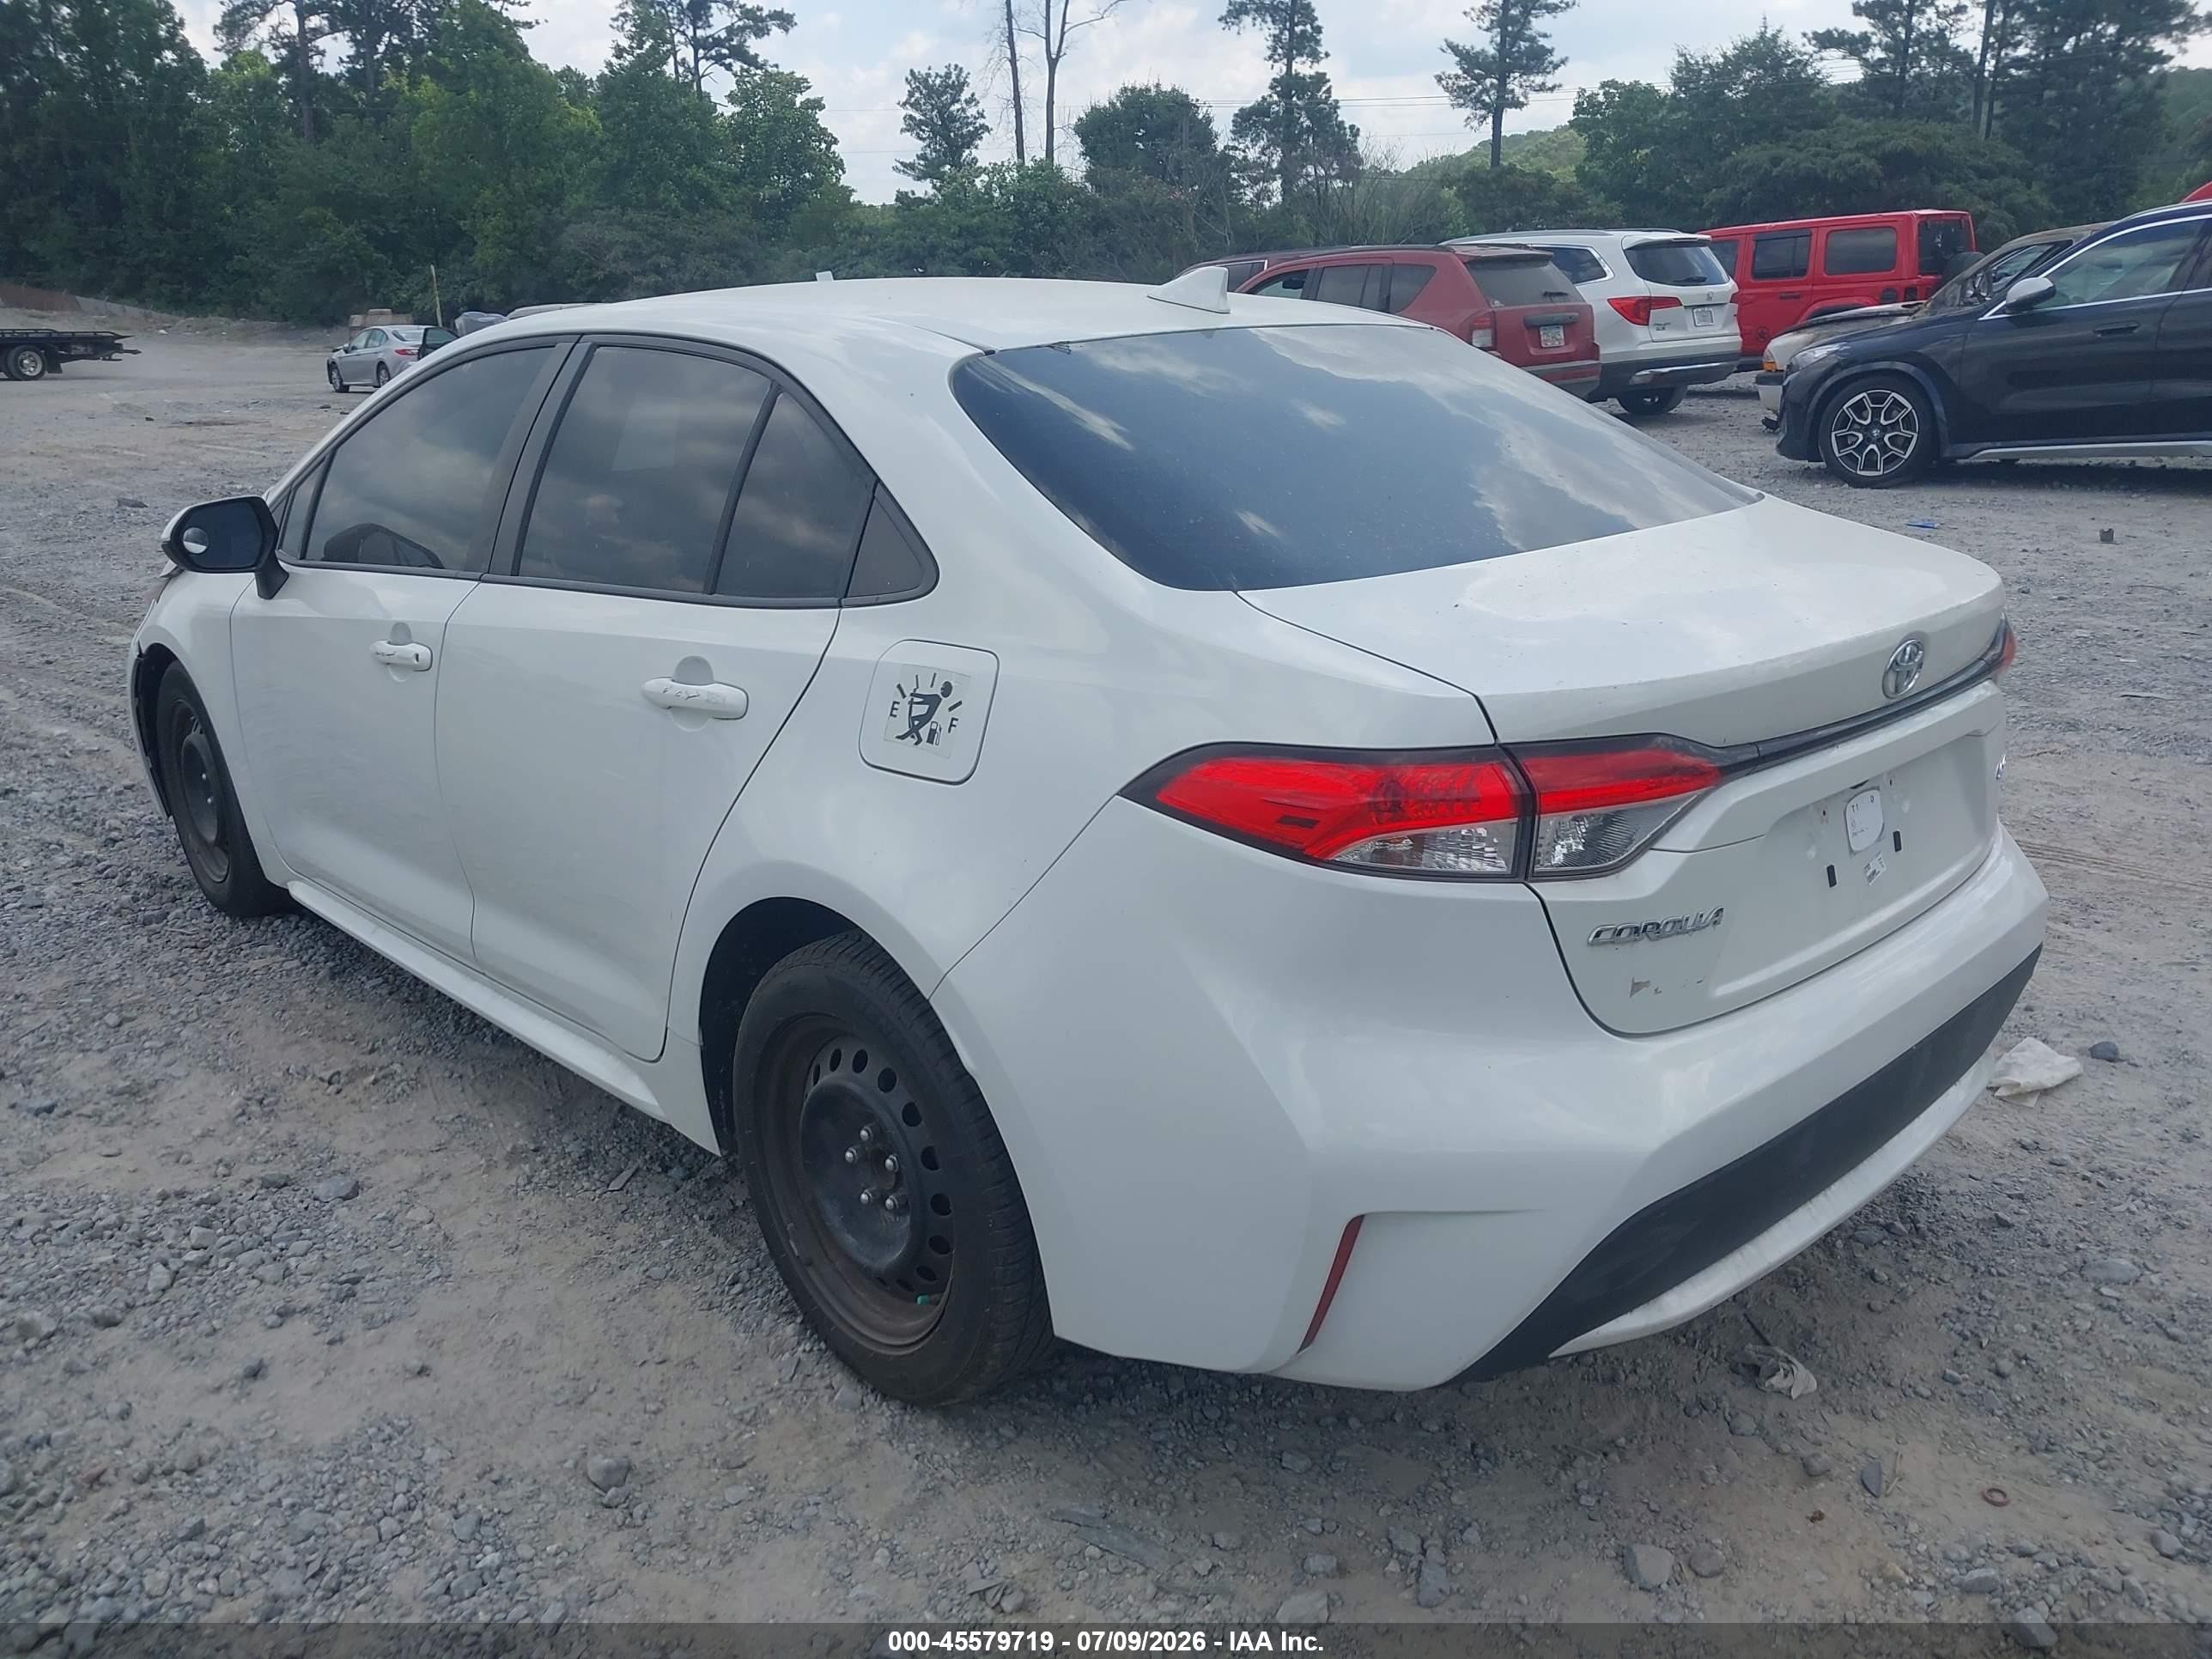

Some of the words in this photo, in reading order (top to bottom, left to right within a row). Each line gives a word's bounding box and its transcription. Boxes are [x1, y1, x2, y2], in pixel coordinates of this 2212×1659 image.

[890, 701, 900, 718] E
[948, 717, 959, 733] F
[1587, 906, 1725, 945] COROLLA
